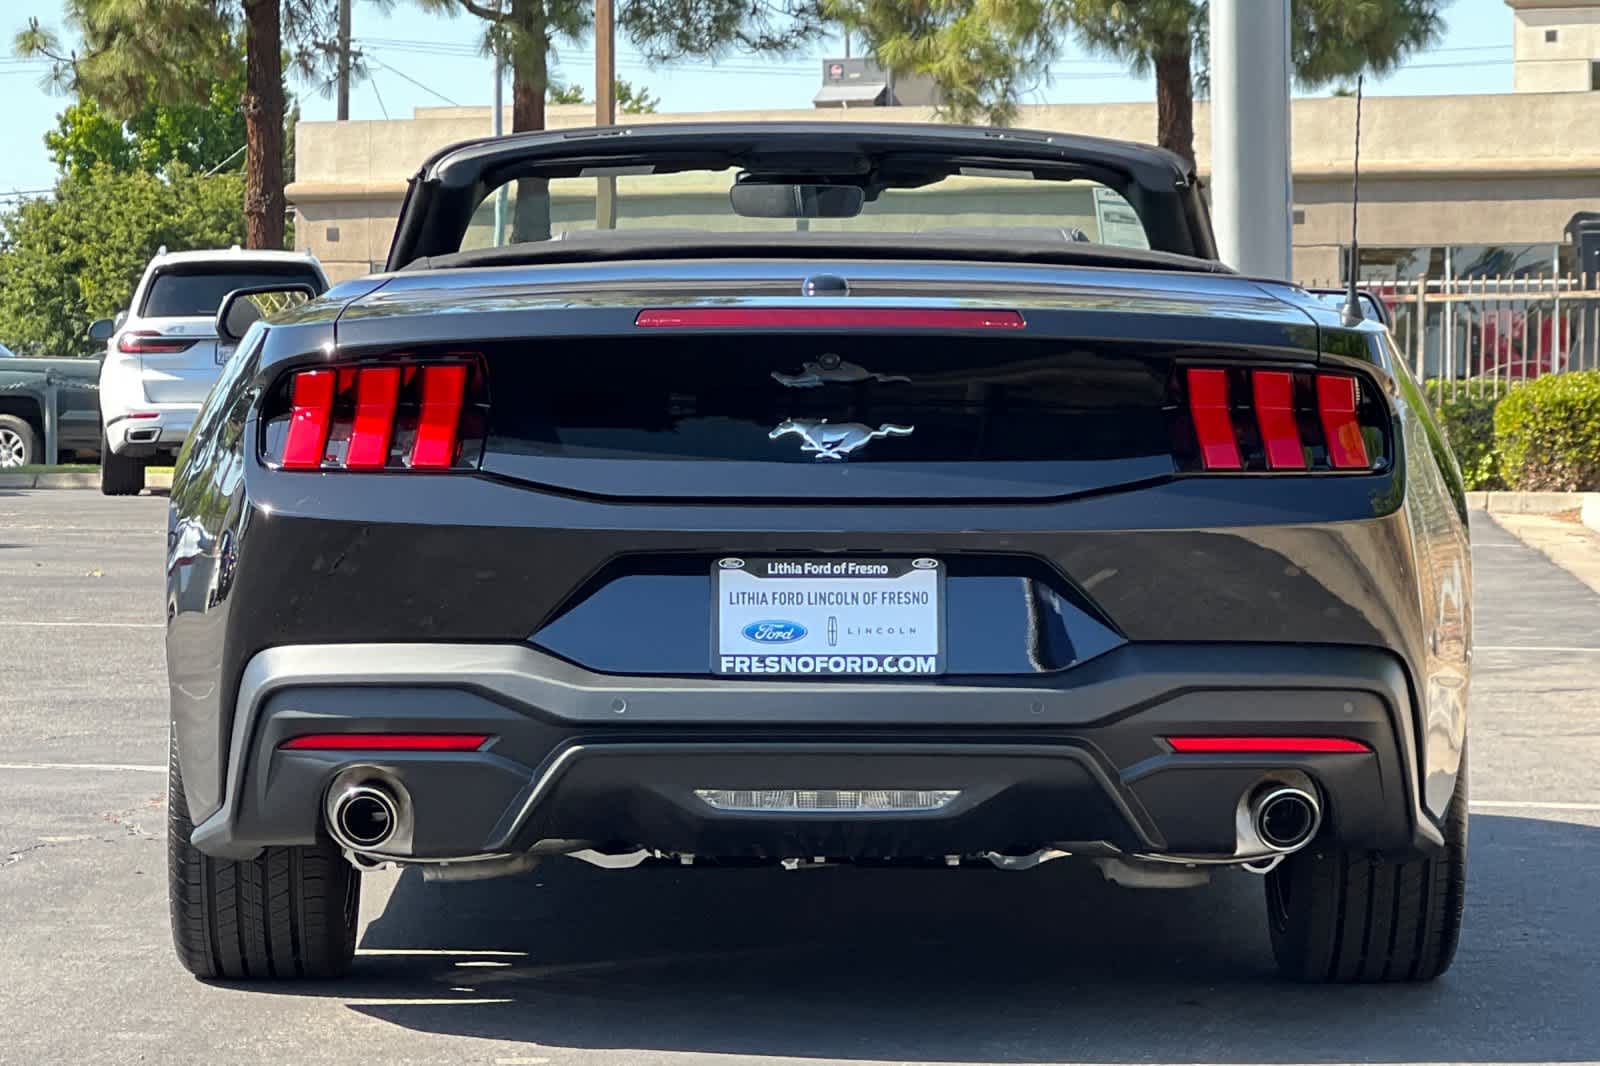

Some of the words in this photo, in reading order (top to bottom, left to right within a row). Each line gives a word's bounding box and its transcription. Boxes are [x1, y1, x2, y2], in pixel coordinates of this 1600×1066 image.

[767, 562, 802, 575] Lithia
[804, 562, 831, 575] Ford
[834, 562, 847, 575] of
[848, 562, 889, 575] Fresno
[729, 591, 769, 606] LITHIA
[772, 591, 803, 606] FORD
[807, 591, 860, 606] LINCOLN
[863, 591, 878, 606] OF
[881, 591, 929, 605] FRESNO
[754, 623, 795, 641] Ford
[847, 626, 917, 635] LINCOLN
[721, 656, 936, 673] FRESNOFORD.COM
